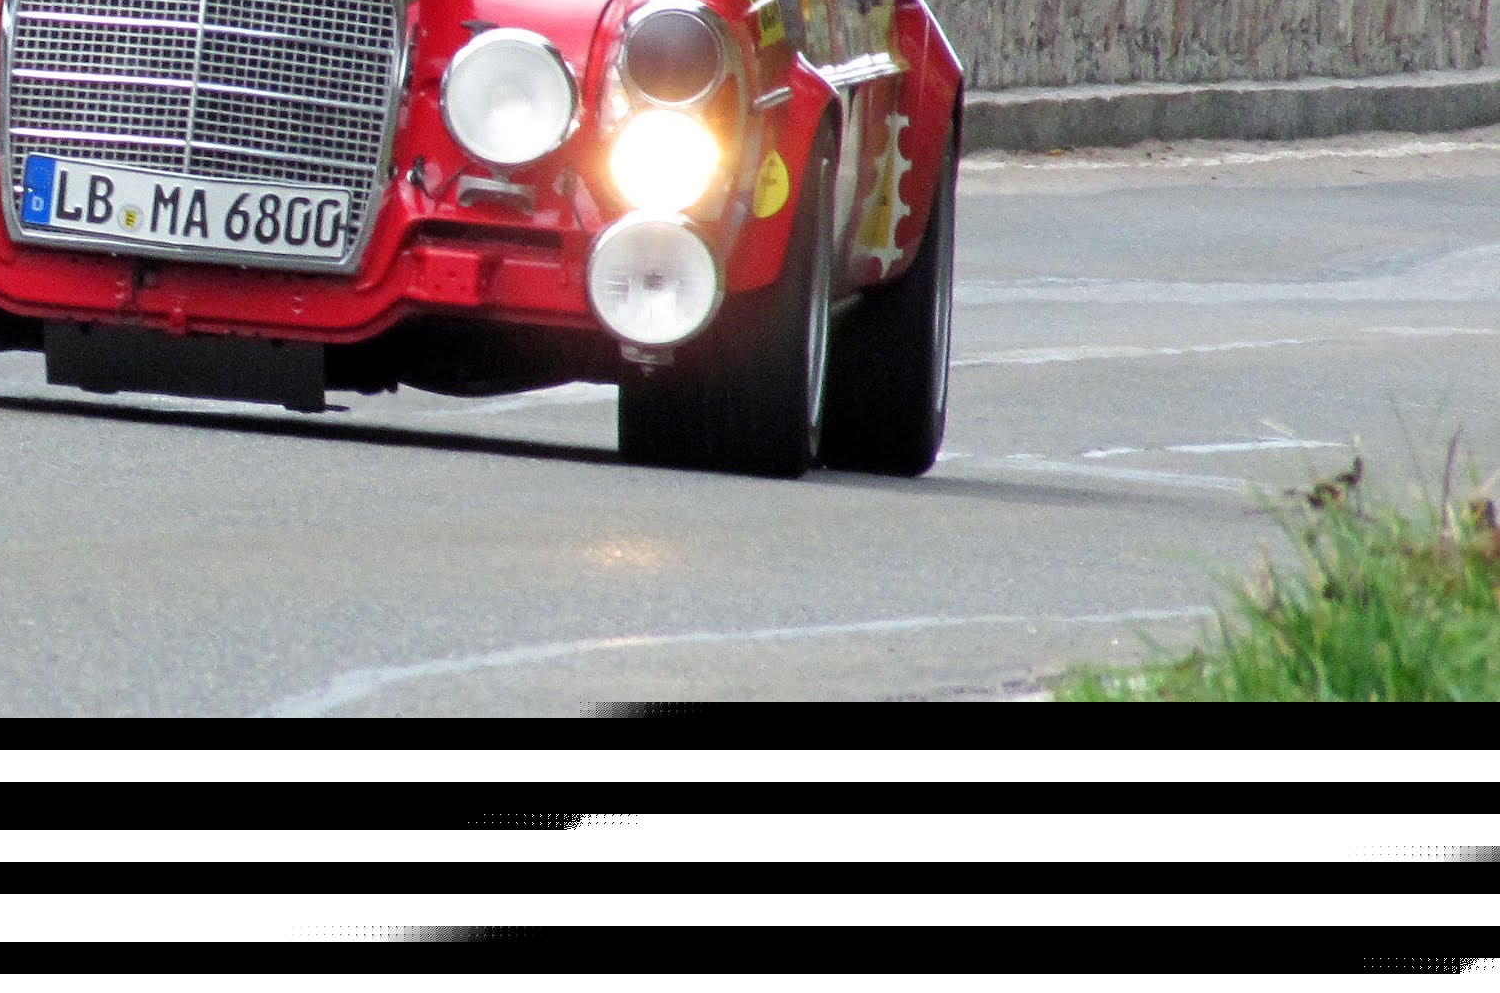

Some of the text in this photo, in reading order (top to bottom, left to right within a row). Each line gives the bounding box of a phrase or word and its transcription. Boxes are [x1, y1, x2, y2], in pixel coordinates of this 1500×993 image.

[31, 195, 45, 212] D
[56, 170, 342, 248] LB MA 6800
